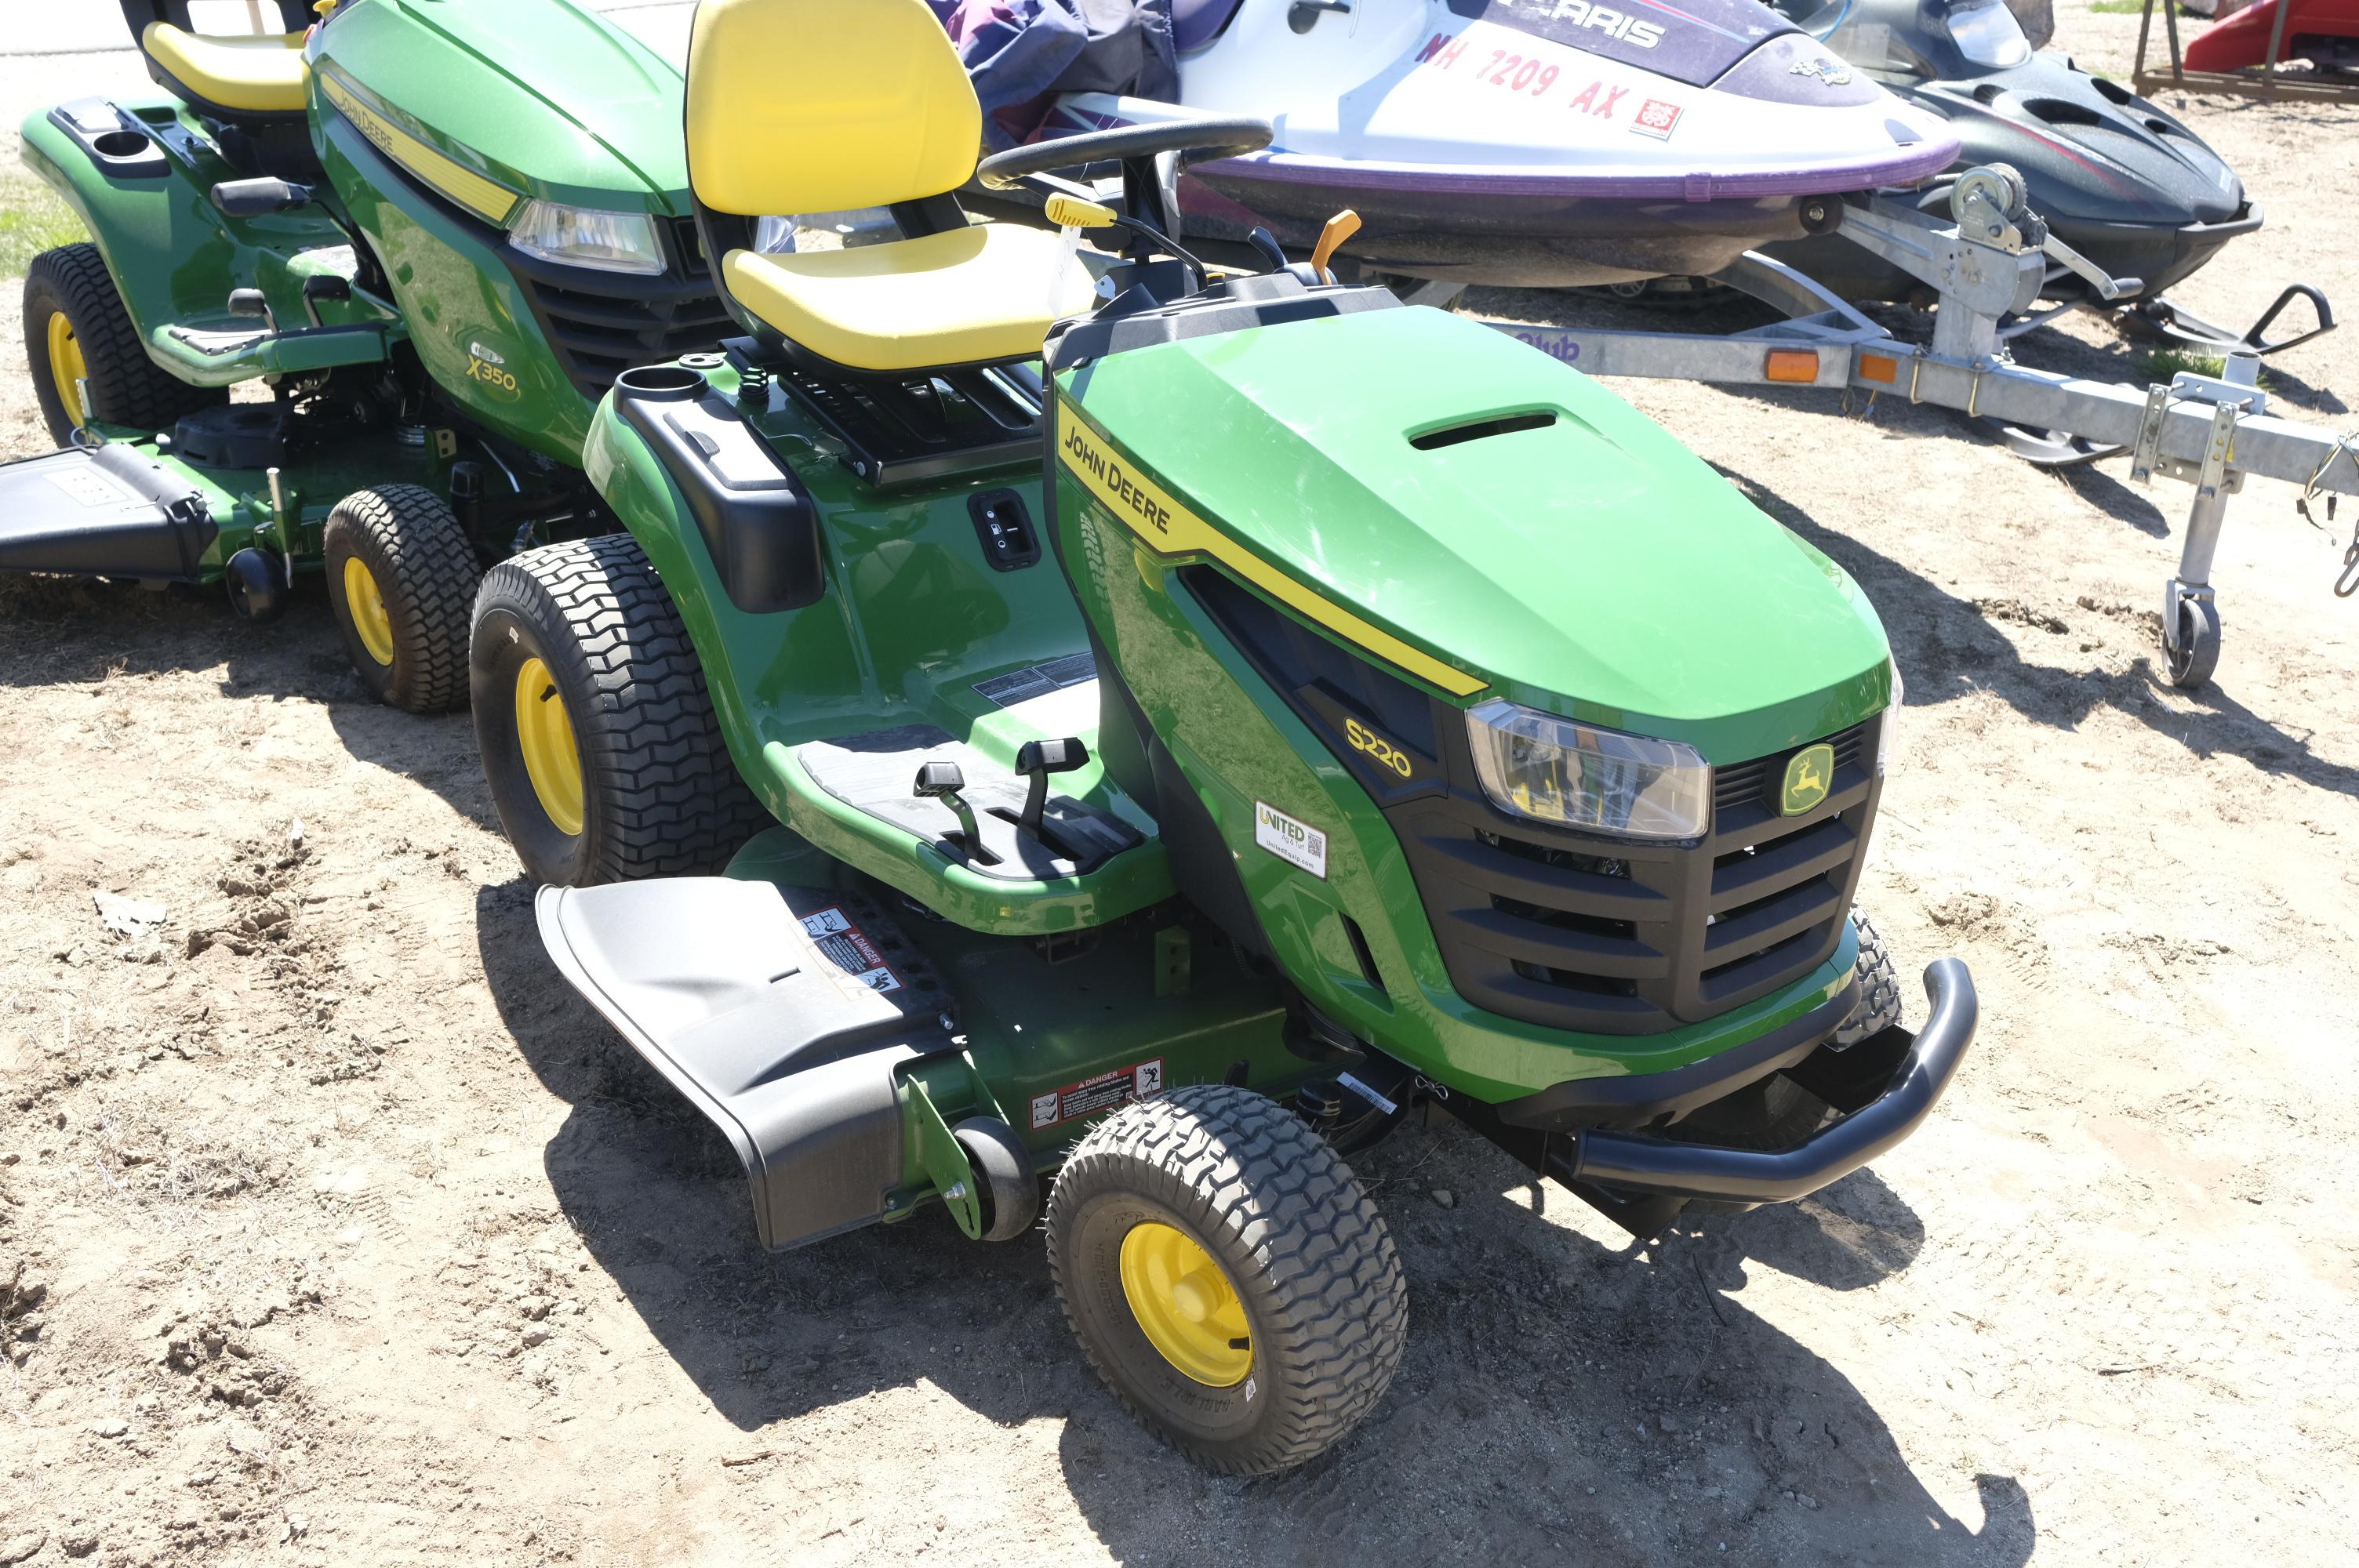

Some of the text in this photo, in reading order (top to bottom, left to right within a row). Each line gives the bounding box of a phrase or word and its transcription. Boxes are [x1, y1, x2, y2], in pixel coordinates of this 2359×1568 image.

[1496, 0, 1667, 49] ARIS
[1415, 32, 1469, 70] NH
[1476, 49, 1560, 96] 7209
[1568, 81, 1630, 120] AX
[340, 91, 394, 152] JOHN DEERE
[465, 354, 516, 390] X350
[1065, 426, 1171, 535] JOHN DEERE
[1345, 718, 1412, 778] S220
[1259, 806, 1305, 842] UNITED
[1266, 840, 1314, 869] UnitedEquip.com
[1281, 834, 1289, 844] Ag
[1296, 840, 1305, 851] Turf
[854, 938, 881, 964] DANGER
[1085, 1071, 1118, 1086] DANGER
